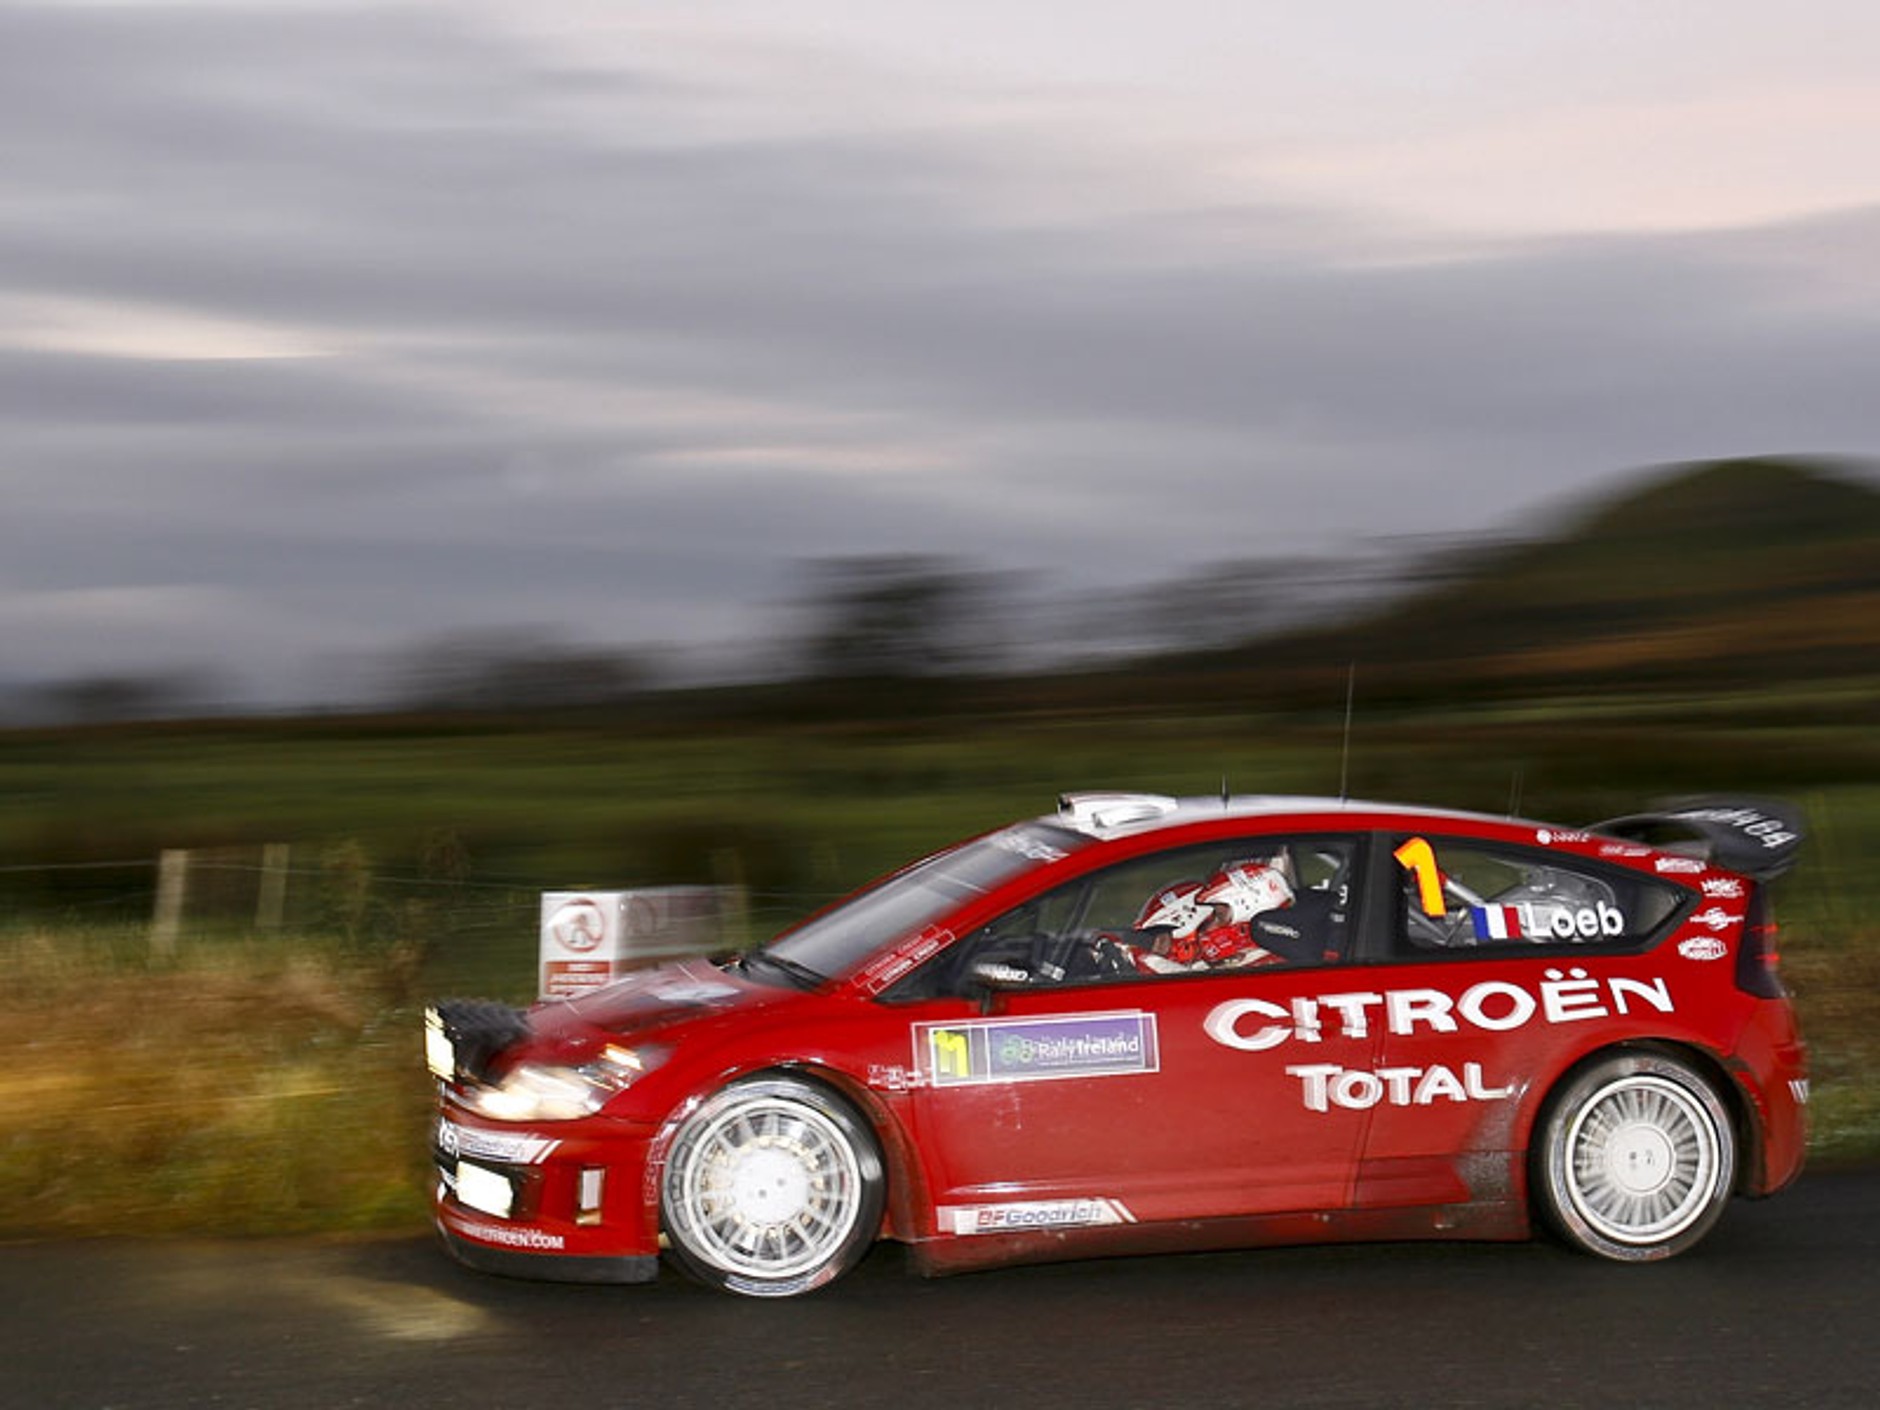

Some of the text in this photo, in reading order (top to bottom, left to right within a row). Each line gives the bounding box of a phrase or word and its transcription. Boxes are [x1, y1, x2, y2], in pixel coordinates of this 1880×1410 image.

[1394, 836, 1446, 917] 1
[1525, 900, 1624, 936] Loeb
[1203, 968, 1675, 1051] CITROËN
[1286, 1062, 1511, 1111] TOTAL
[977, 1202, 1102, 1225] BFGoodrich
